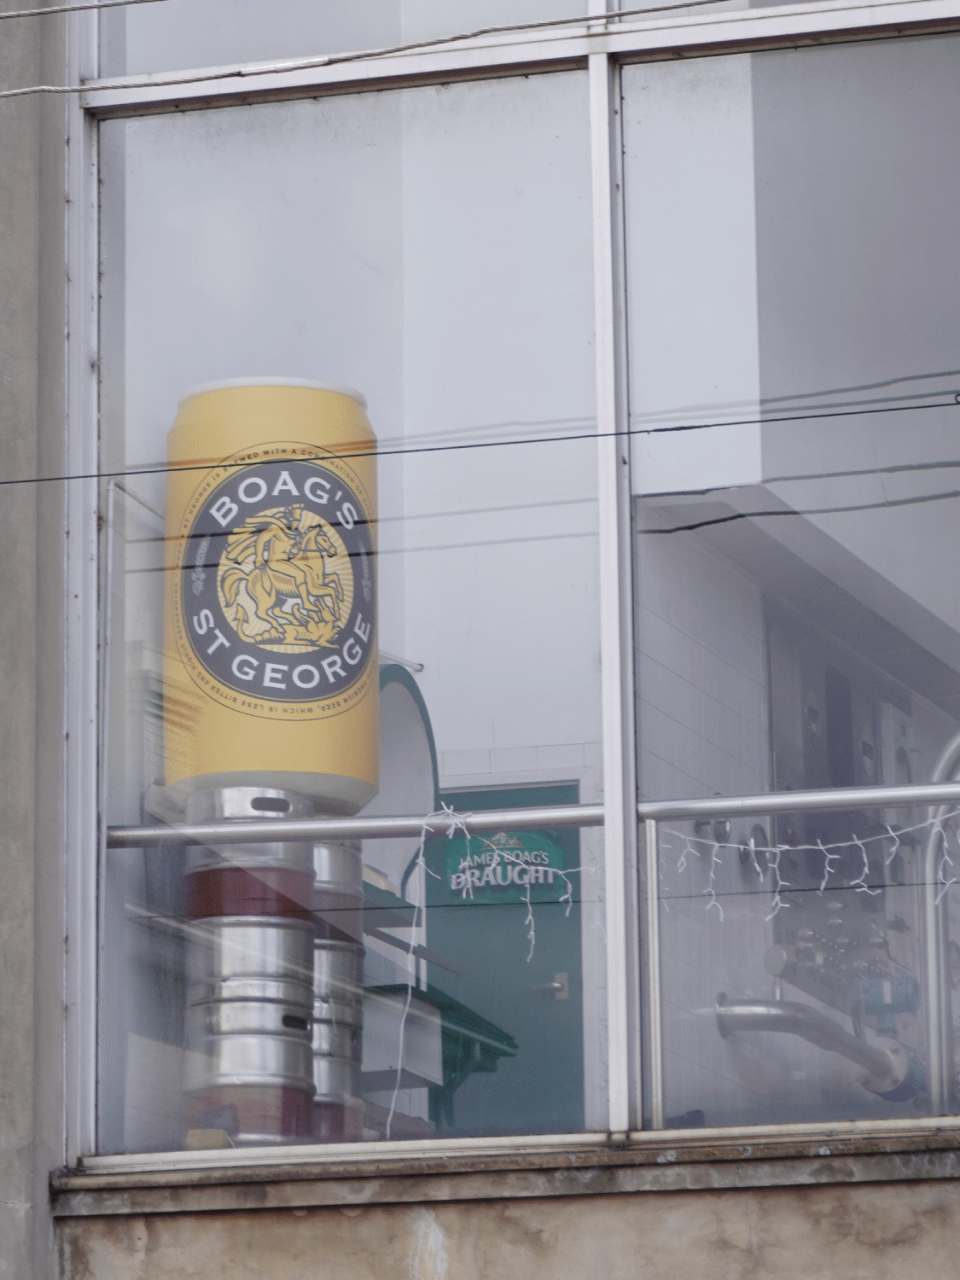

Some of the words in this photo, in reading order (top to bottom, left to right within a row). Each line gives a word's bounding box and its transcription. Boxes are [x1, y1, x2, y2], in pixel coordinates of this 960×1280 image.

[209, 470, 359, 531] BOAG'S
[193, 608, 230, 656] ST
[232, 612, 371, 690] GEORGE
[450, 865, 554, 890] DRAUGHT
[504, 849, 550, 865] BOAG'S
